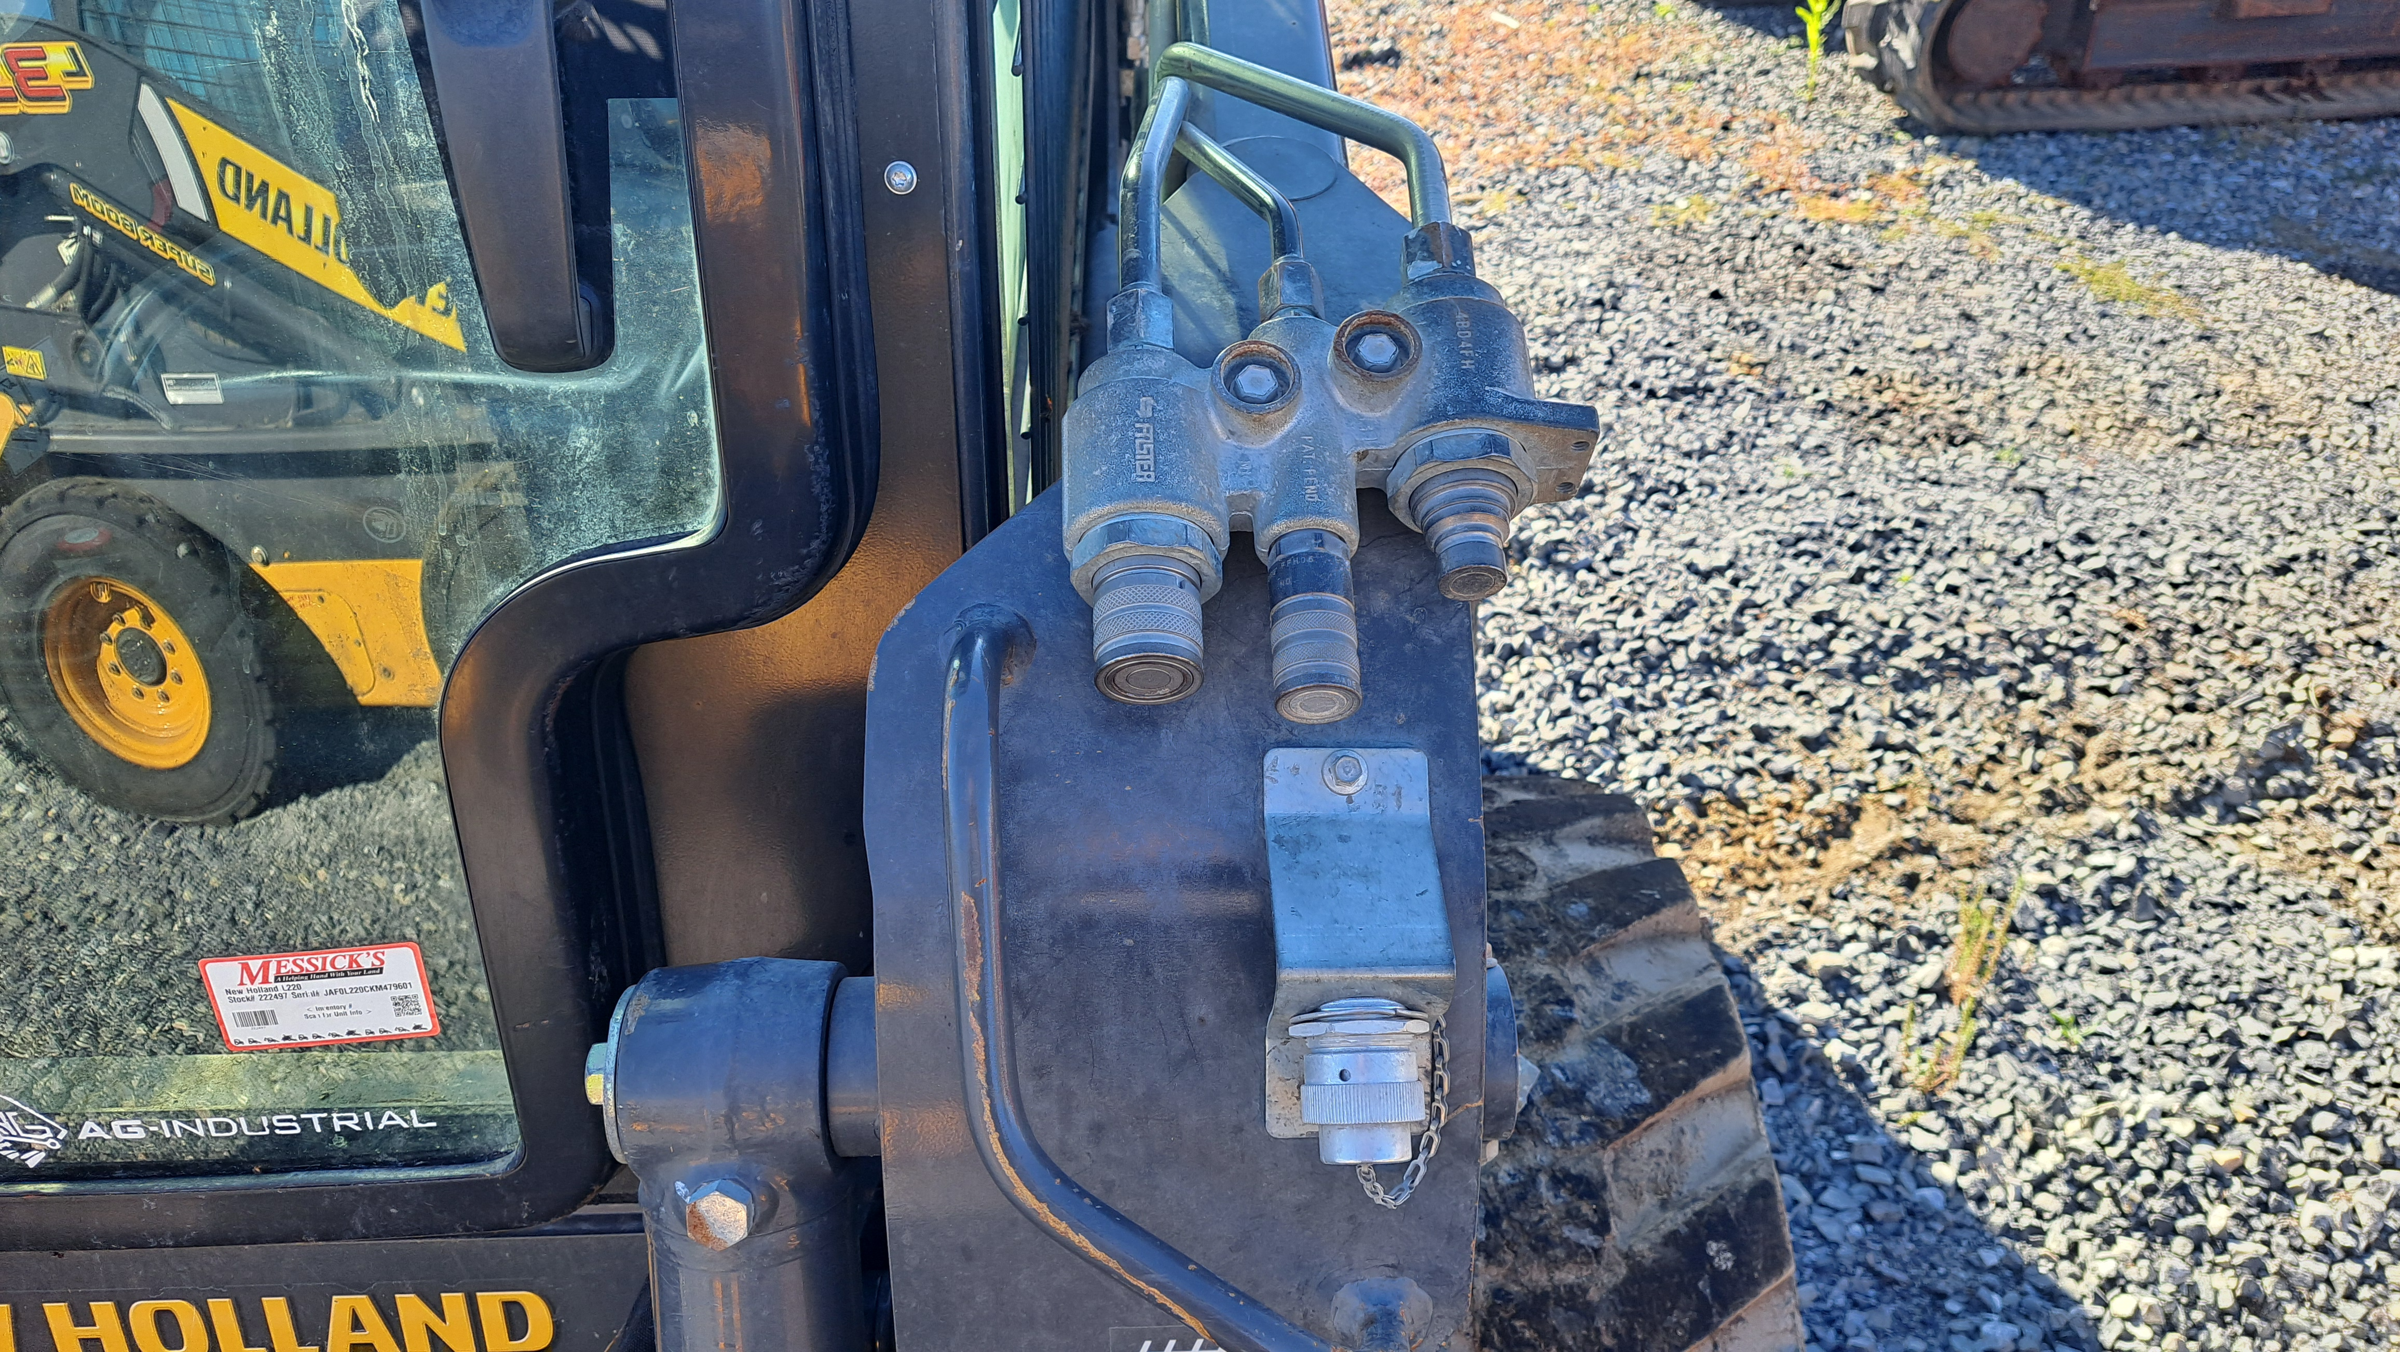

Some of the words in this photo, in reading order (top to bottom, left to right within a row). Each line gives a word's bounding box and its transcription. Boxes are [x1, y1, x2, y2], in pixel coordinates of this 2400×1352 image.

[1135, 422, 1155, 482] FASTER
[237, 950, 386, 986] MESSICK'S
[282, 974, 309, 982] Helping
[225, 988, 243, 996] New
[246, 985, 279, 994] Holland
[281, 983, 302, 992] L220
[258, 992, 288, 1002] 222497
[334, 1010, 348, 1018] Unit
[78, 1108, 438, 1141] AG-INDUSTRIAL
[42, 1290, 555, 1352] HOLLAND
